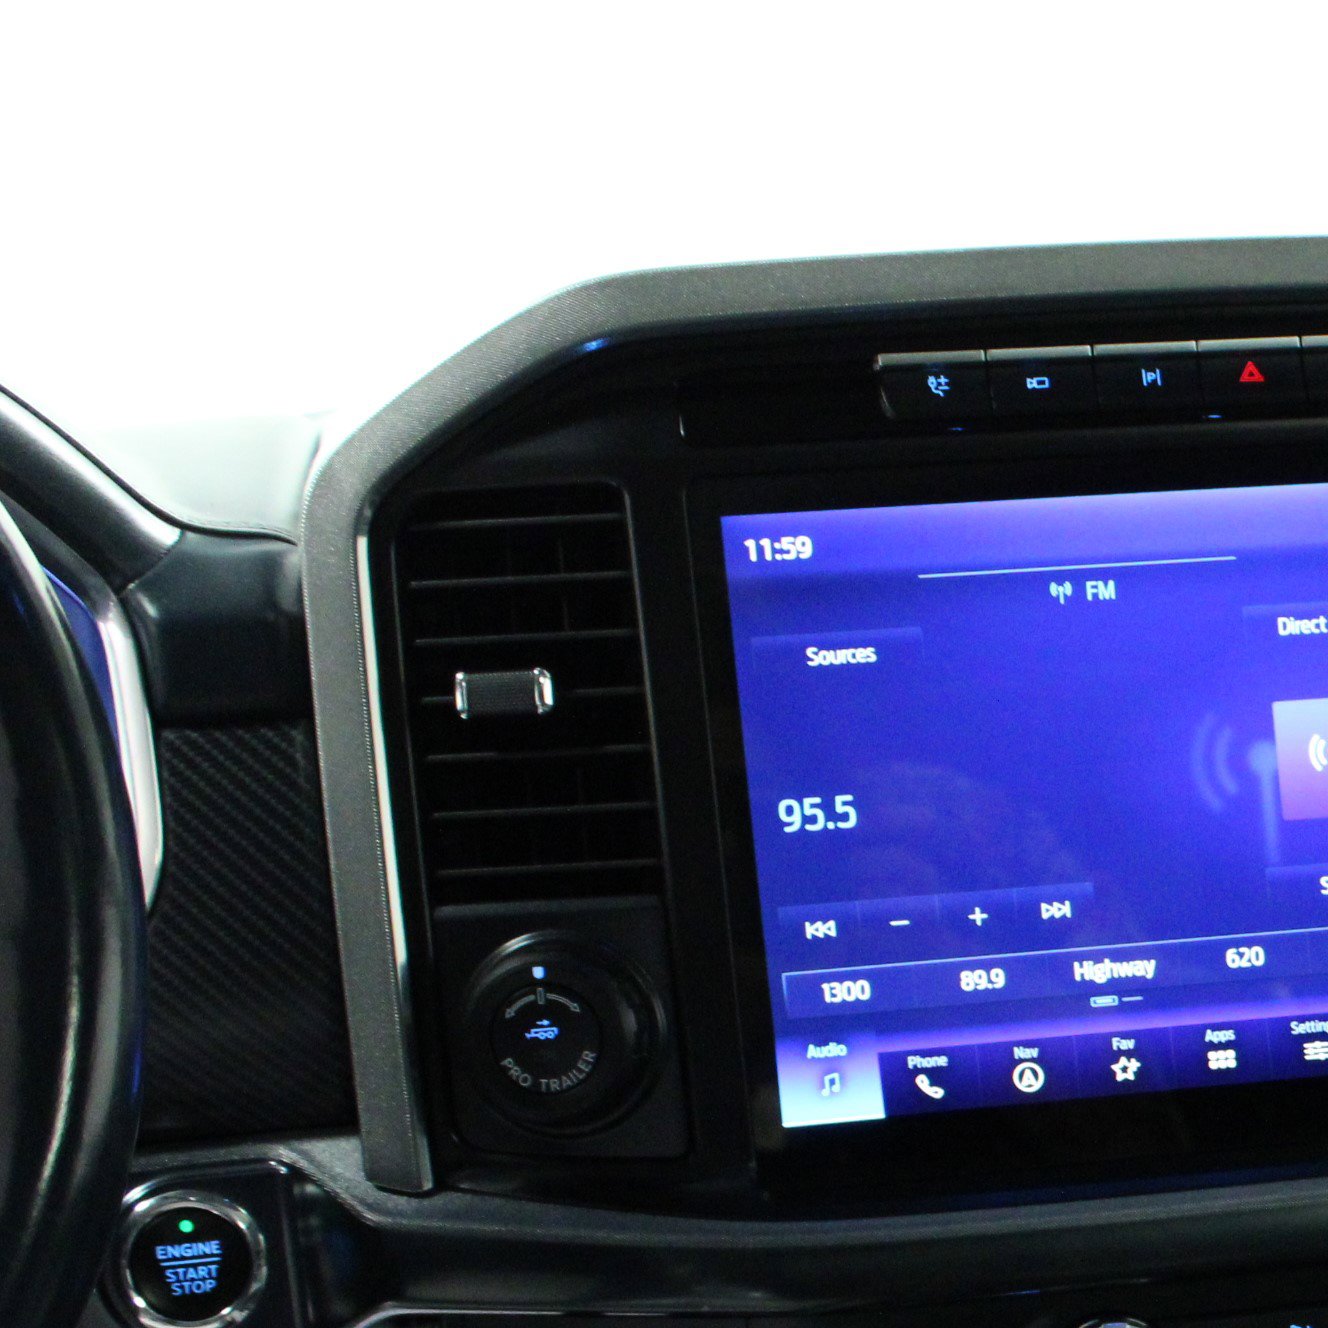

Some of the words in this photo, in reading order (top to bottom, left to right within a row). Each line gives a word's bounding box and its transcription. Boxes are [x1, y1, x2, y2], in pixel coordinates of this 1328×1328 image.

[744, 536, 813, 562] 11:59
[1085, 579, 1116, 602] FM
[1277, 613, 1328, 636] Direct
[806, 643, 878, 667] Sources
[778, 794, 858, 833] 95.5
[1225, 945, 1266, 969] 620
[959, 968, 1006, 992] 89.9
[1073, 956, 1157, 984] Highway
[821, 978, 871, 1004] 1300
[1111, 1036, 1136, 1051] Fav
[1204, 1026, 1236, 1045] Apps
[807, 1041, 848, 1060] Audio
[907, 1052, 948, 1070] Phone
[1013, 1044, 1039, 1060] Nav
[500, 1056, 532, 1088] PRO
[539, 1050, 598, 1093] TRAILER
[155, 1240, 223, 1260] ENGINE
[165, 1264, 220, 1283] START
[170, 1280, 217, 1297] STOP
